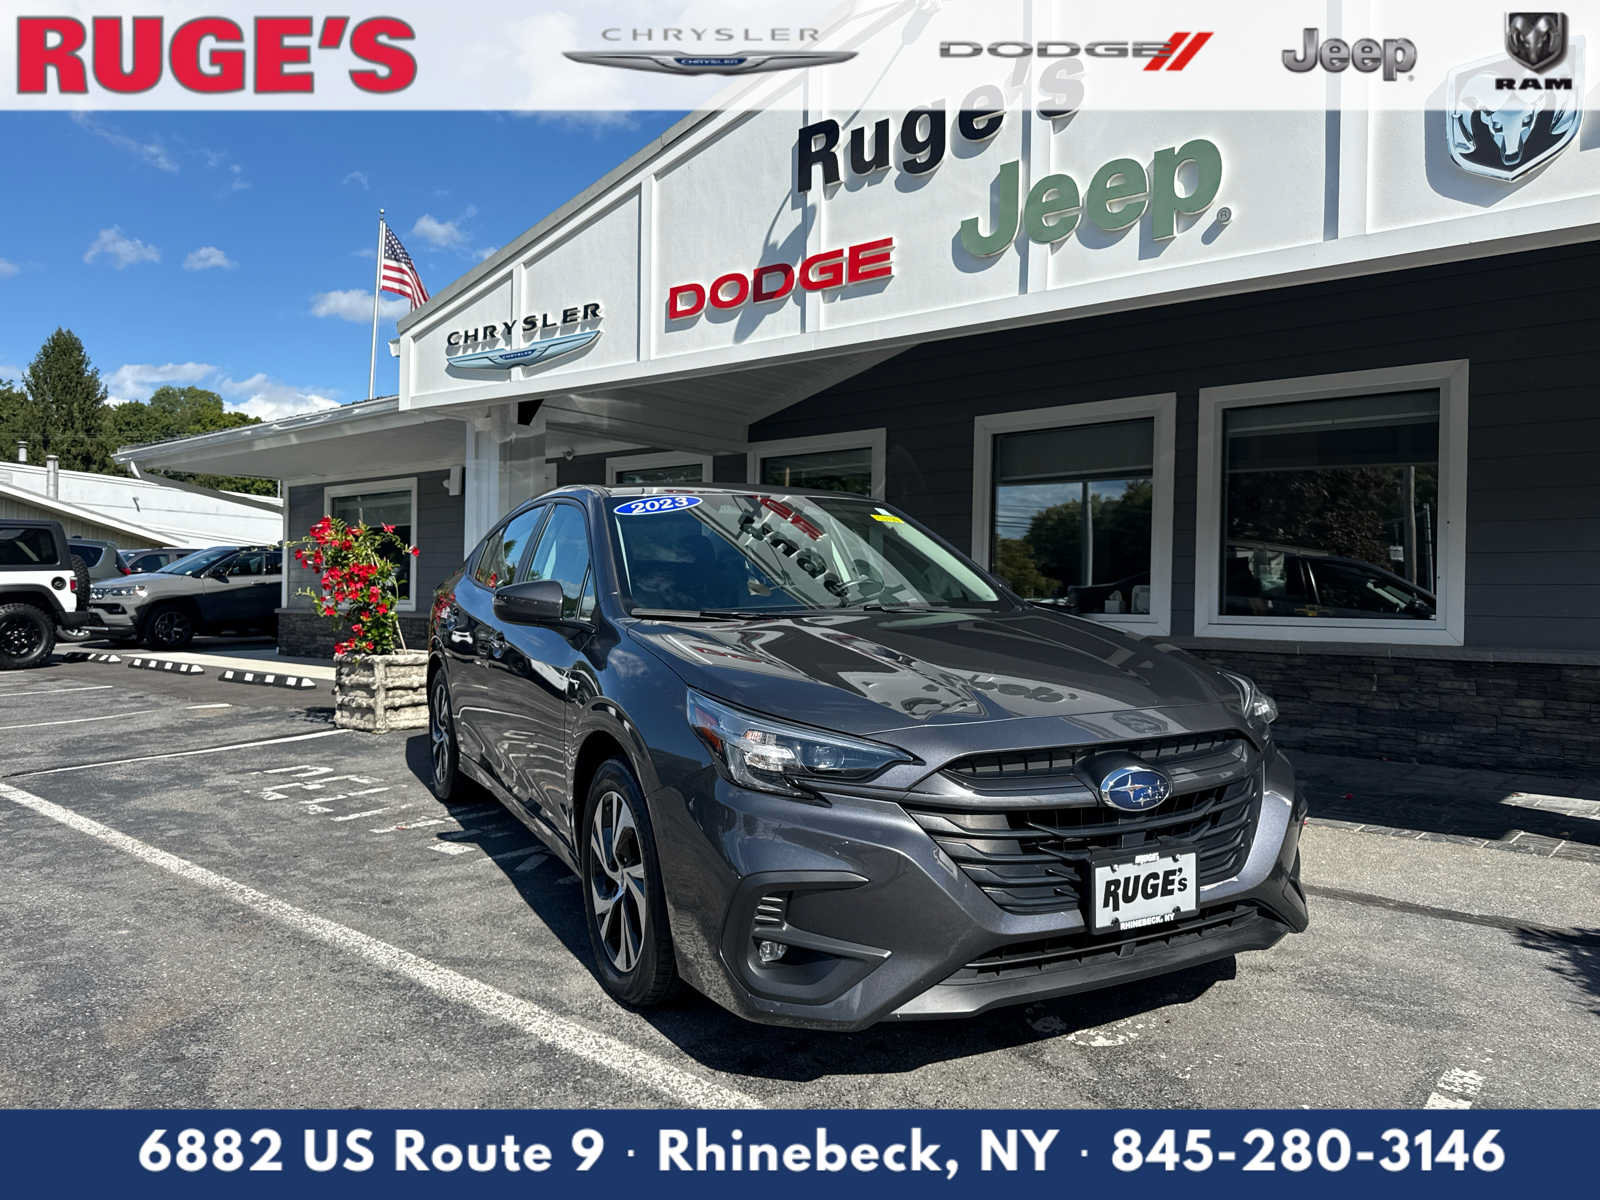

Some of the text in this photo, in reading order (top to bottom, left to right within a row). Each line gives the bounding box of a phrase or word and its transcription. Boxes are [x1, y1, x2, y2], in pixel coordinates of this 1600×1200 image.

[960, 138, 1223, 257] Jeep
[668, 237, 894, 321] DODGE
[446, 302, 601, 346] CHRYSLER
[630, 497, 689, 514] 2023
[1102, 867, 1188, 913] RUGE's
[1164, 912, 1176, 923] NY
